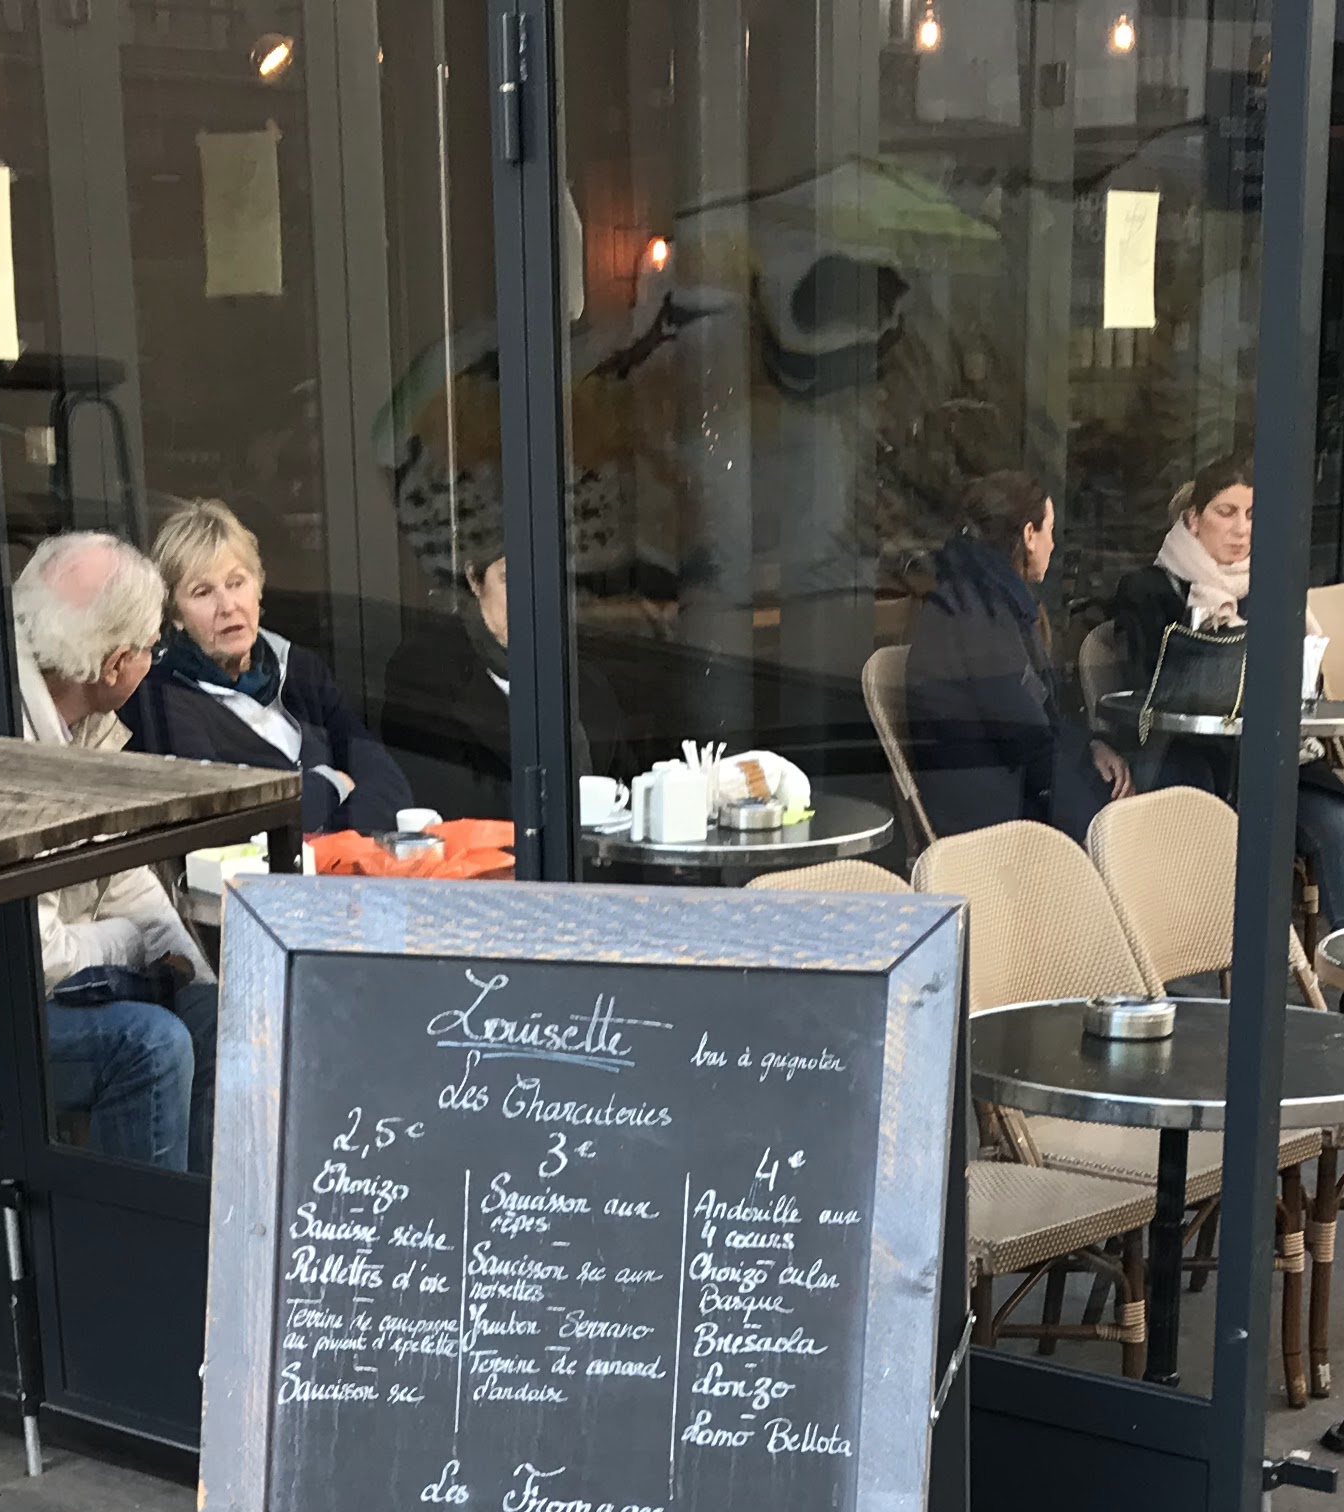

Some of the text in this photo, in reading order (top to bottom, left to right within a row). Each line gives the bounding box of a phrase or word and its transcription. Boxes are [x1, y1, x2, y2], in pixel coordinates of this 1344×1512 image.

[690, 1031, 728, 1067] bar
[760, 1048, 846, 1082] grignoter
[438, 1050, 672, 1126] Les Charcuteries
[312, 1158, 409, 1214] Chorizo
[481, 1172, 660, 1219] Saucisson aux
[693, 1189, 802, 1224] Andouille
[701, 1219, 717, 1248] 4
[285, 1245, 384, 1288] Rillettes
[468, 1240, 569, 1281] Saucisson
[615, 1267, 664, 1283] aux
[689, 1252, 768, 1293] Chorizo
[286, 1298, 459, 1339] Terrine de campagne
[699, 1283, 794, 1322] Basque
[283, 1332, 308, 1350] au
[460, 1303, 655, 1352] Jambon Serrano
[693, 1322, 828, 1357] Bresaola
[278, 1361, 379, 1405] Saucisson
[470, 1350, 666, 1379] Terrine de canard
[681, 1410, 853, 1457] Lomo Bellota
[420, 1459, 469, 1504] Les
